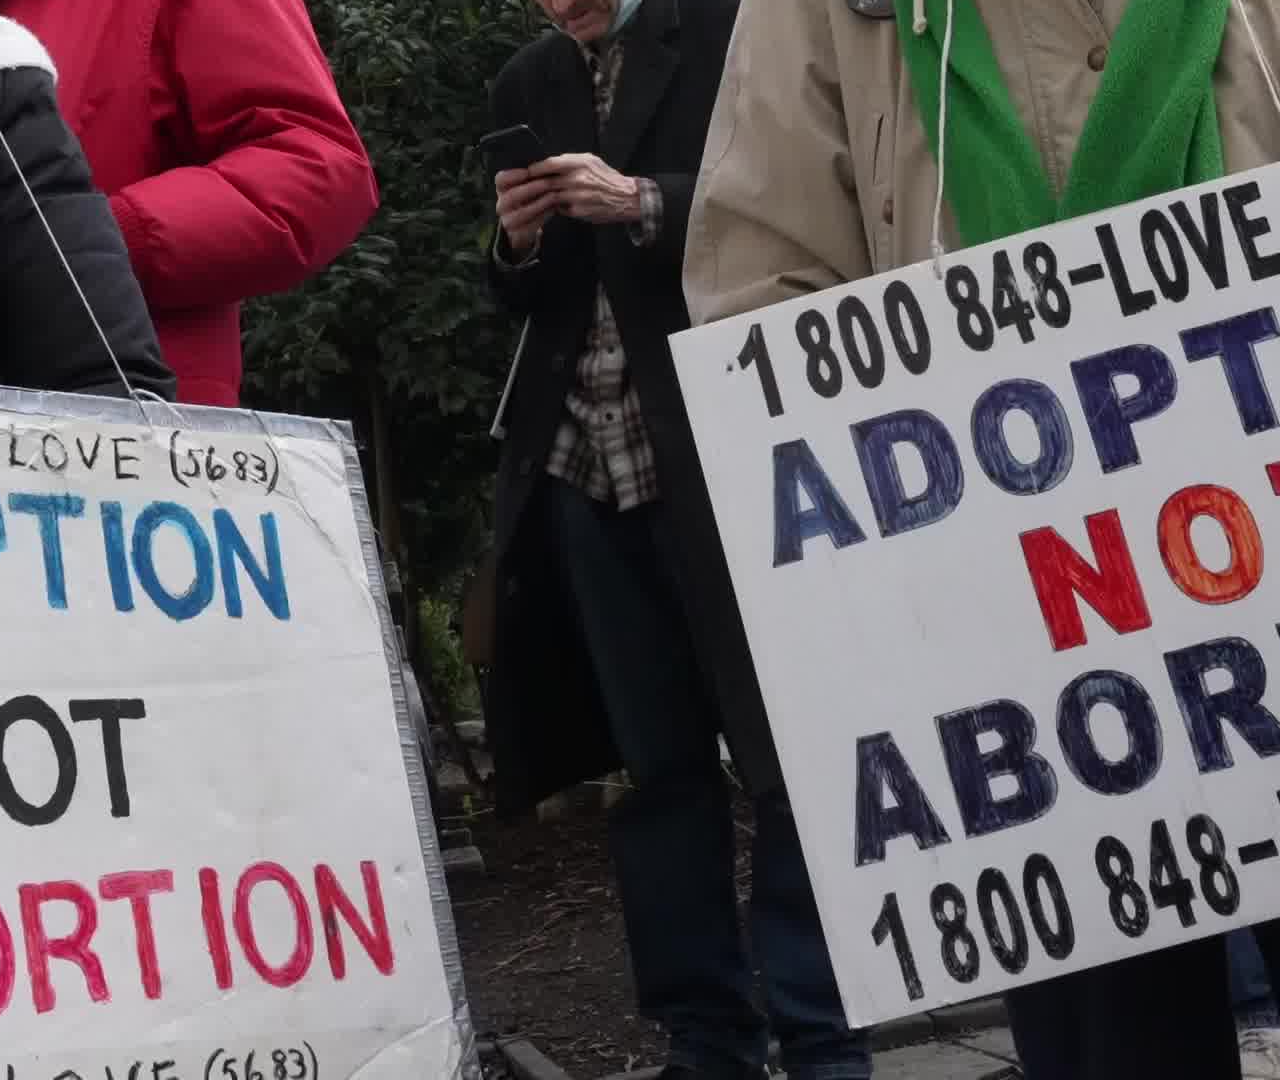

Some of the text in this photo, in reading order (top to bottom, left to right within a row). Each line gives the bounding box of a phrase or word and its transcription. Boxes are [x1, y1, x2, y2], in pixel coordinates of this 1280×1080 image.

[737, 323, 784, 418] 1
[796, 280, 932, 400] 800
[169, 429, 281, 496] (5683)
[871, 892, 924, 1002] 1
[930, 852, 1076, 984] 800
